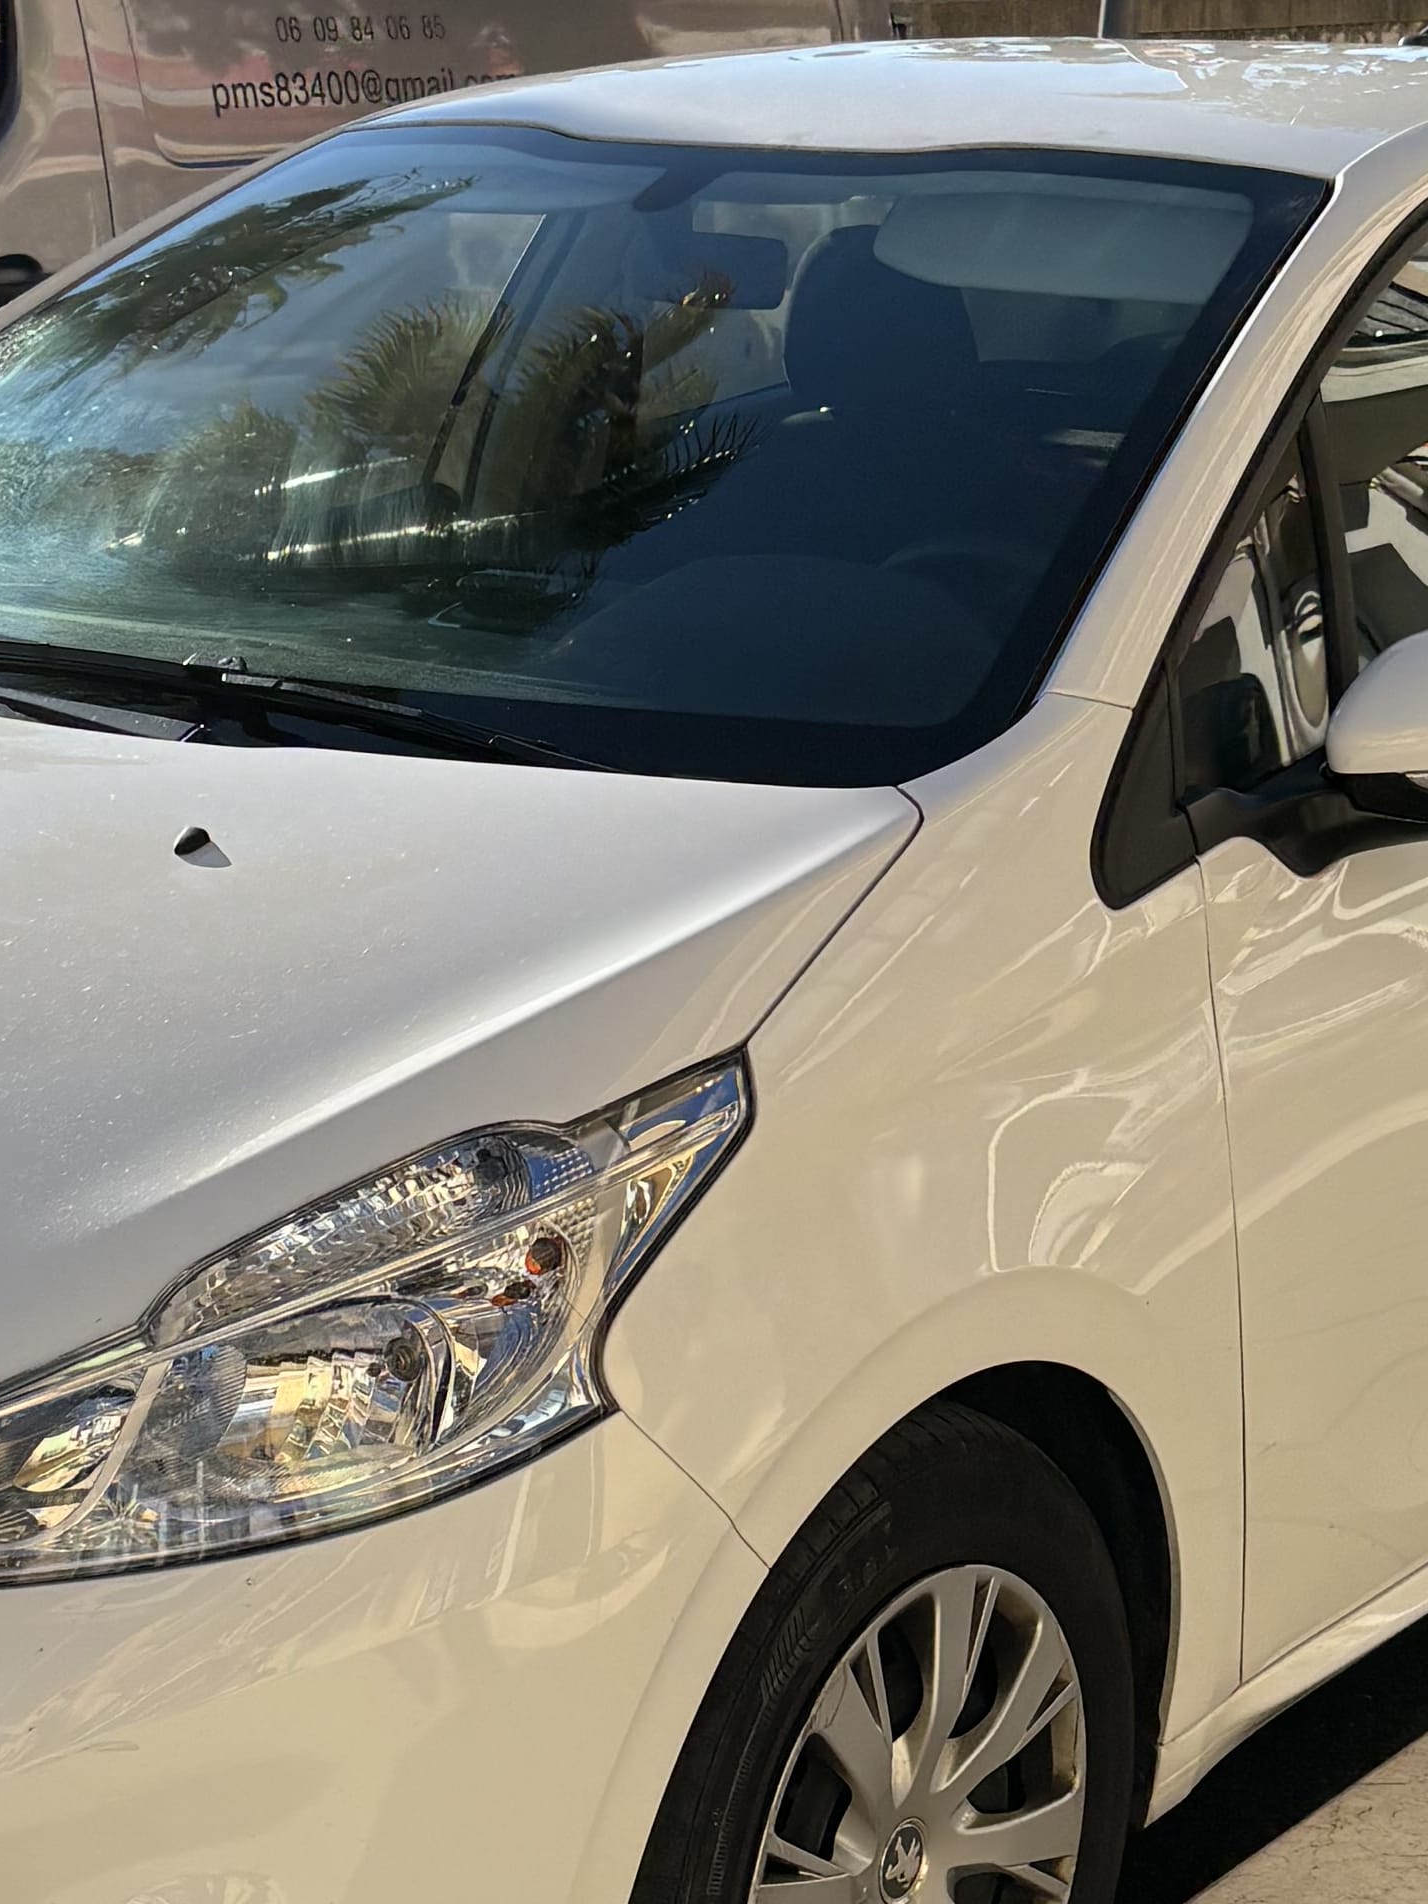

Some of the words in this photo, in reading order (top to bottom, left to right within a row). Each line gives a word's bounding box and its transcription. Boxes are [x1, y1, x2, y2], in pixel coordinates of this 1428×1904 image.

[275, 16, 301, 43] 06
[313, 16, 339, 42] 09
[350, 15, 374, 41] 84
[386, 15, 410, 40] 06
[211, 67, 517, 118] pms83400@gmail
